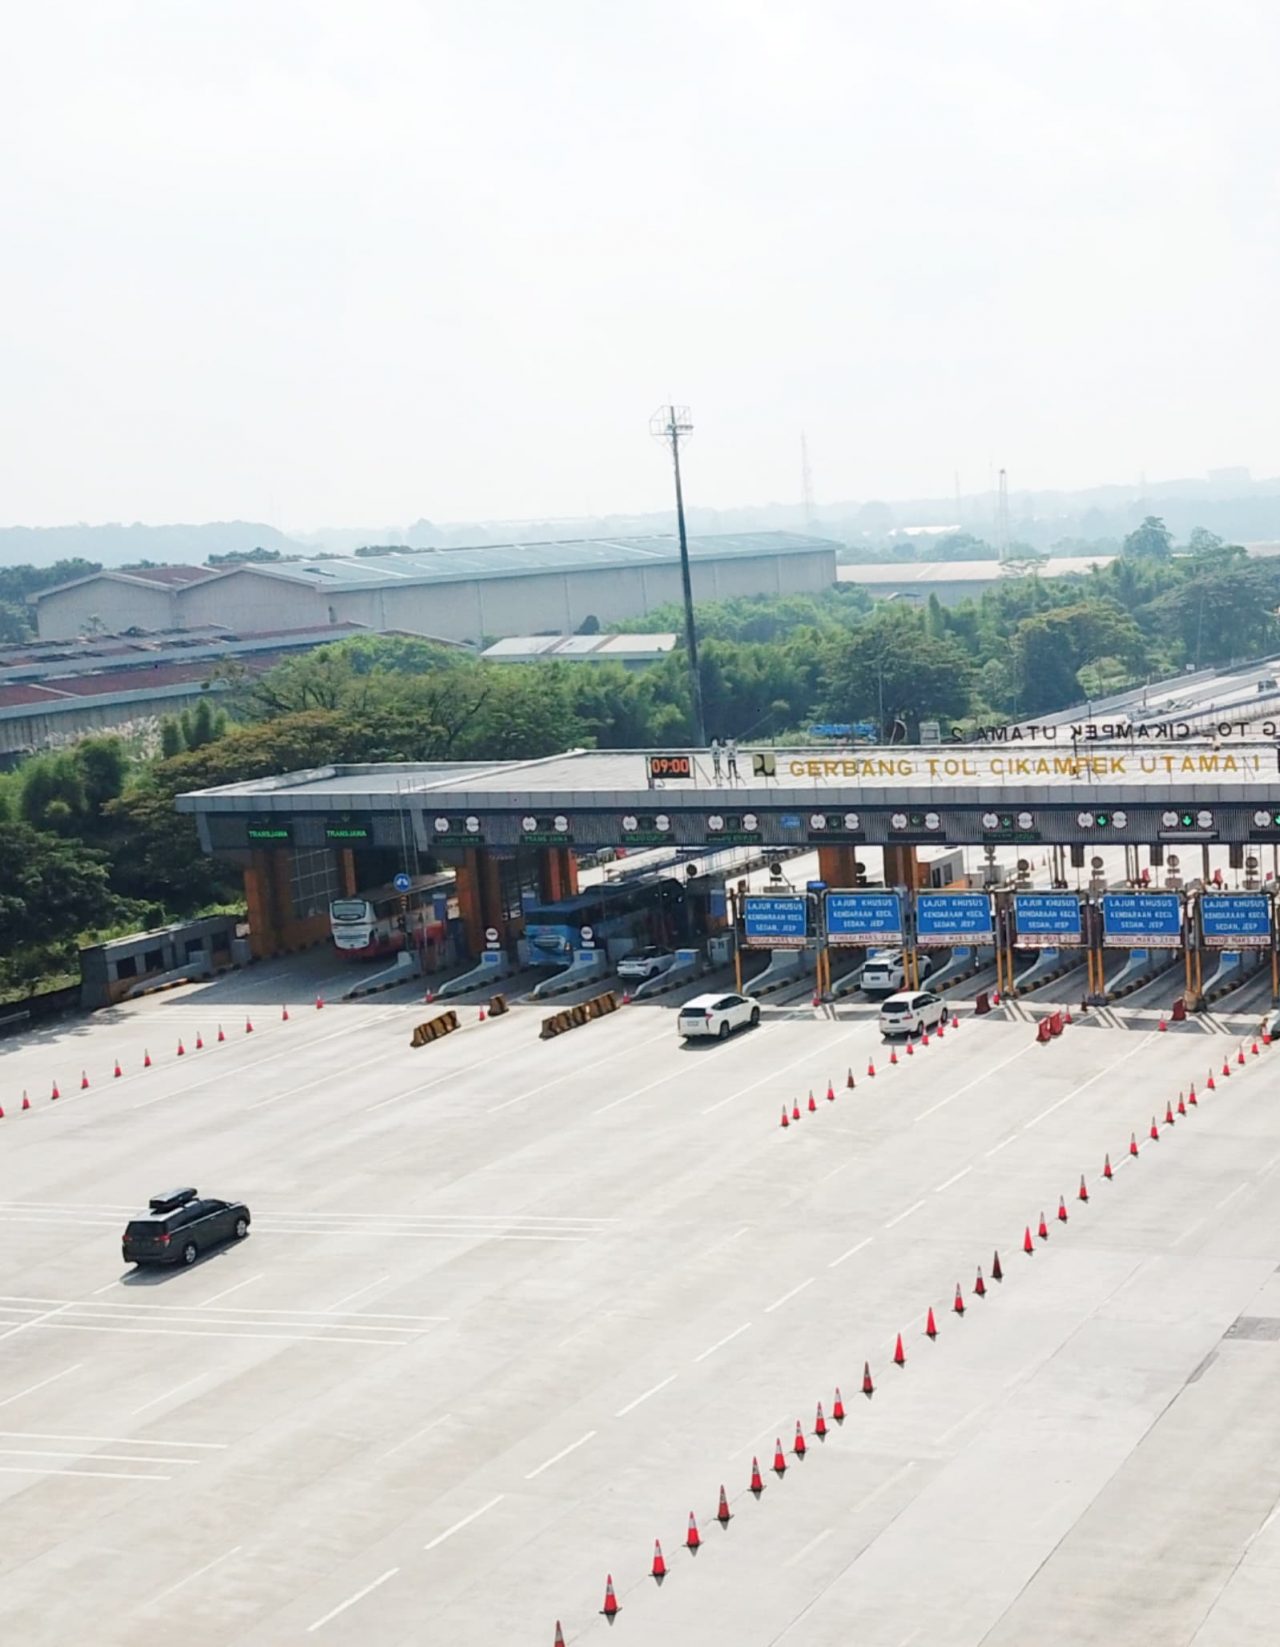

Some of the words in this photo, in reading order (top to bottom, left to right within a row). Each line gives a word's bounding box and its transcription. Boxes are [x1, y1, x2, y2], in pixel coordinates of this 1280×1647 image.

[651, 759, 690, 774] 09:00
[789, 758, 913, 778] GERBANG
[927, 758, 978, 776] TOL
[990, 756, 1127, 776] CIKAMPEK
[1140, 754, 1238, 774] UTAMA
[832, 899, 857, 907] LAJUR
[861, 899, 893, 907] KHUSUS
[923, 899, 947, 907] LAJUR
[952, 899, 984, 907] KHUSUS
[1018, 899, 1043, 907] LAJUR
[1046, 899, 1076, 907] KHUSUS
[1109, 899, 1136, 907] LAJUR
[1140, 899, 1173, 907] KHUSUS
[1204, 900, 1230, 908] LAJUR
[1233, 900, 1265, 908] KHUSUS
